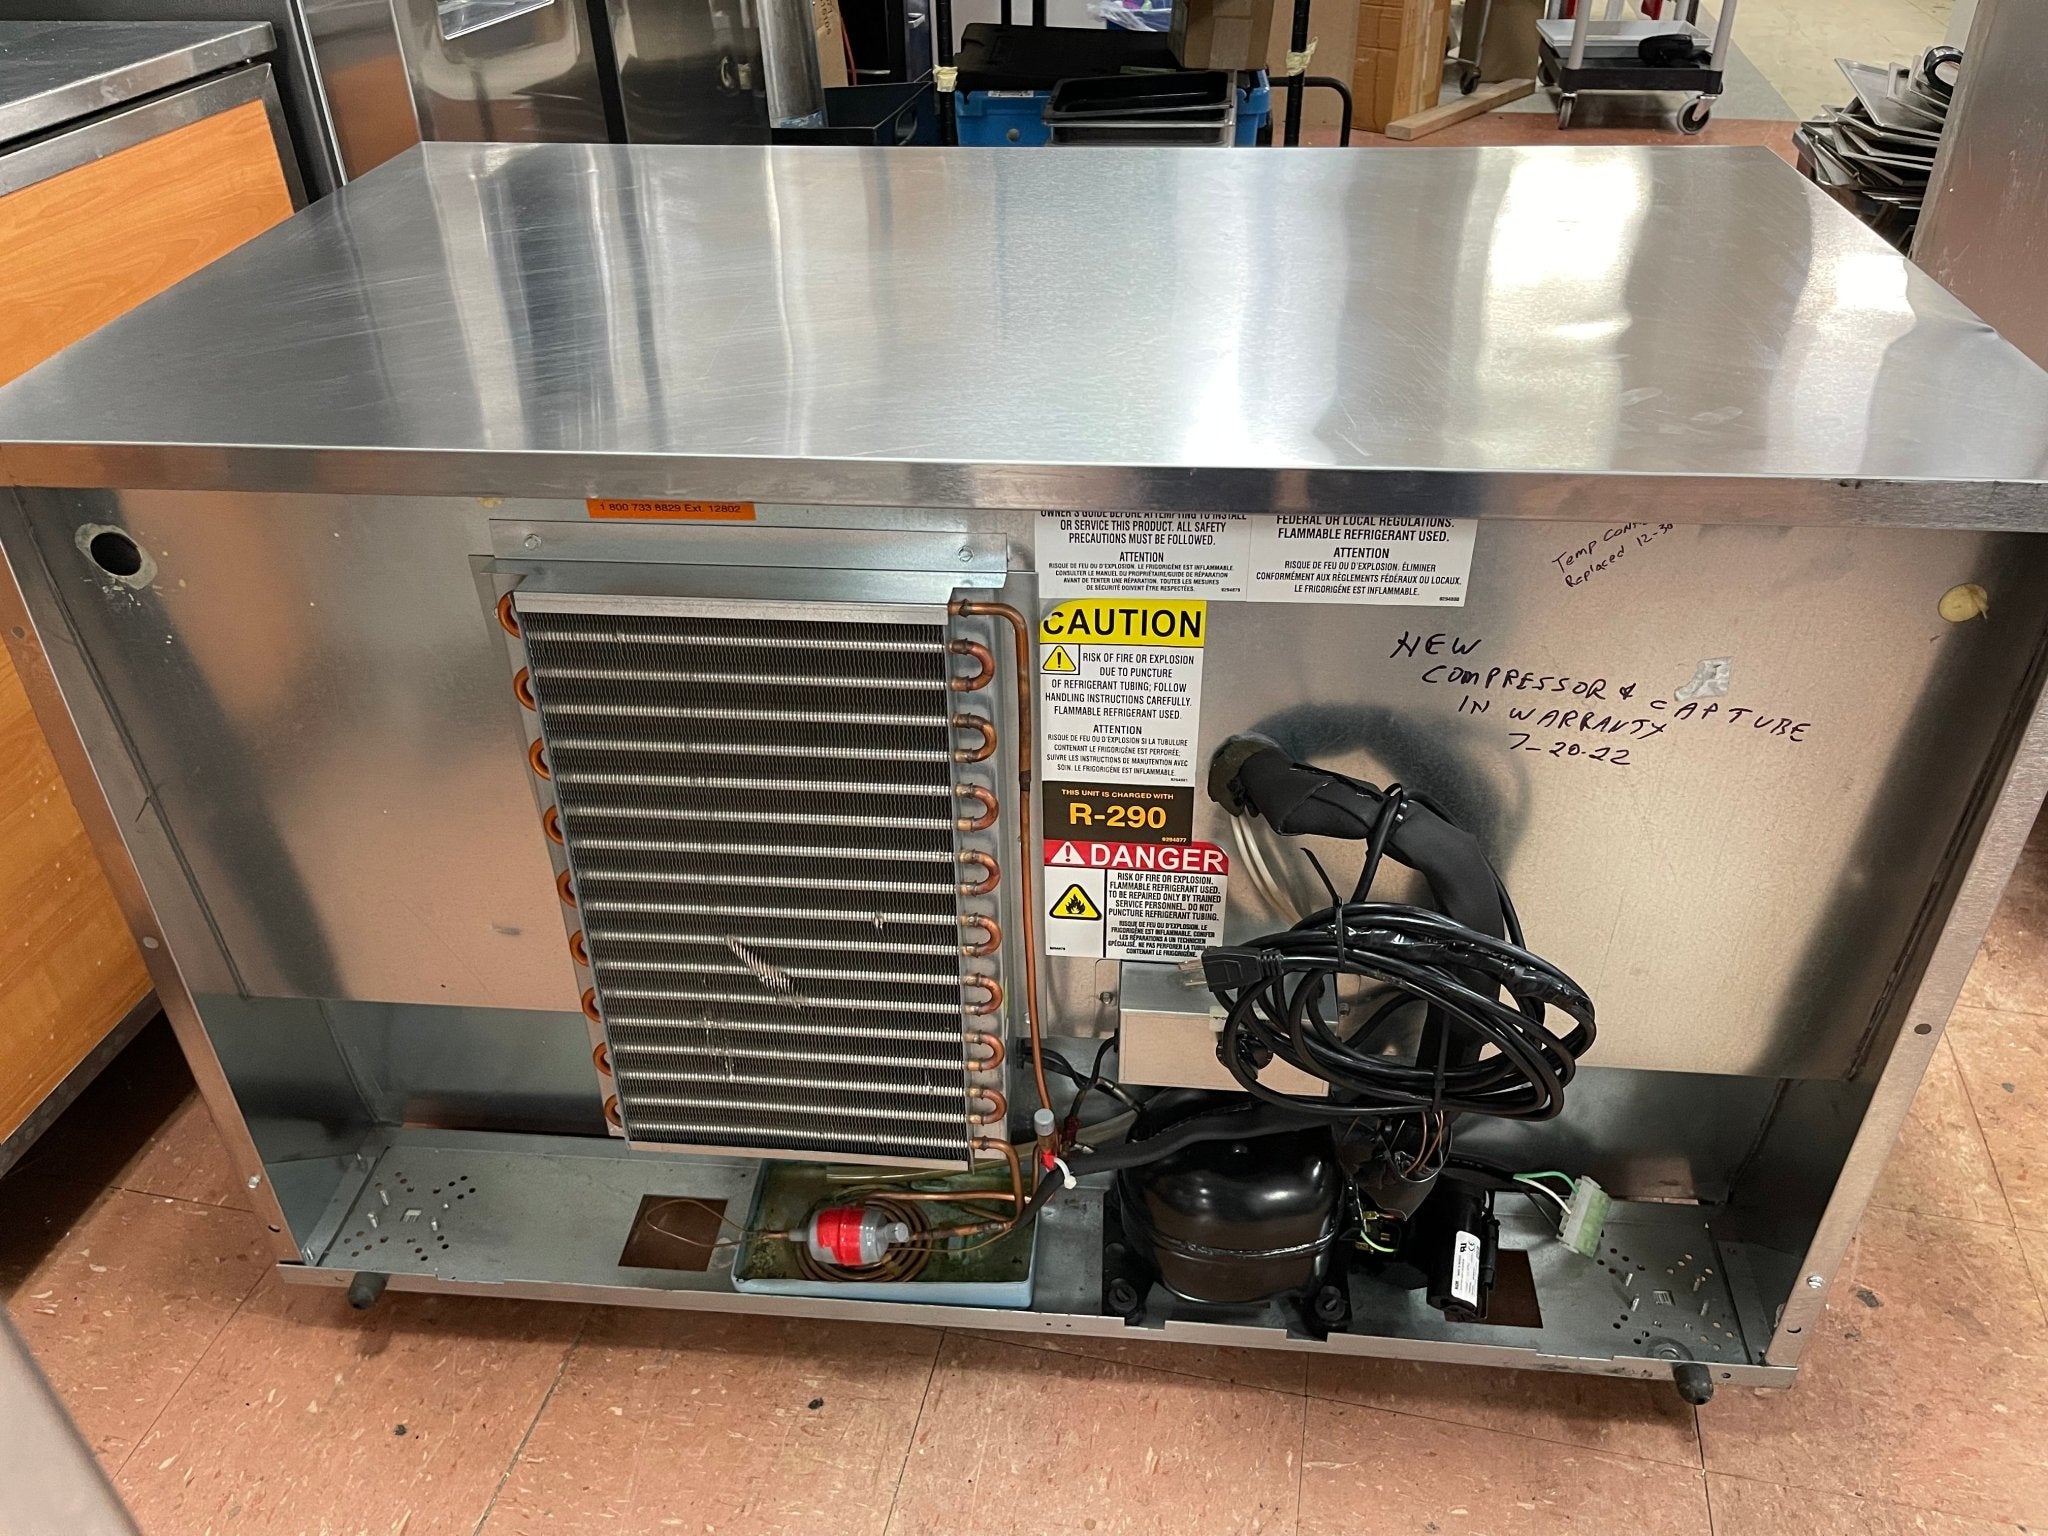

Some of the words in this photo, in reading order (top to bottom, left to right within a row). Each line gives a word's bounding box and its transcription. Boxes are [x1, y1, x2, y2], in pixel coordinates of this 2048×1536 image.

[608, 502, 628, 511] 800
[630, 503, 651, 512] 733
[653, 503, 681, 512] 8829
[707, 504, 741, 513] 12802
[1060, 519, 1072, 531] OR
[1074, 519, 1109, 531] SERVICE
[1110, 520, 1130, 532] THIS
[1132, 520, 1174, 532] PRODUCT.
[1175, 521, 1192, 533] ALL
[1193, 521, 1227, 533] SAFETY
[1276, 515, 1323, 526] FEDERAL
[1323, 516, 1340, 526] OR
[1341, 516, 1377, 527] LOCAL
[1378, 517, 1456, 528] REGULATIONS.
[1068, 533, 1126, 545] PRECAUTIONS
[1128, 533, 1153, 545] MUST
[1154, 533, 1165, 545] BE
[1166, 534, 1217, 546] FOLLOWED.
[1277, 528, 1342, 540] FLAMMABLE
[1342, 529, 1416, 542] REFRIGERANT
[1417, 530, 1451, 542] USED.
[1119, 551, 1165, 563] ATTENTION
[1332, 547, 1391, 559] ATTENTION
[1349, 562, 1400, 572] D'EXPLOSION.
[1401, 563, 1437, 573] ÉLIMINER
[1315, 572, 1331, 582] AUX
[1379, 574, 1418, 584] FÉDÉRAUX
[1418, 574, 1430, 585] OU
[1430, 575, 1463, 585] LOCAUX.
[1351, 585, 1366, 595] EST
[1366, 585, 1421, 596] INFLAMMABLE.
[1042, 608, 1201, 638] CAUTION
[1389, 631, 1482, 658] NEW
[1082, 653, 1101, 663] RISK
[1103, 653, 1113, 663] OF
[1115, 653, 1133, 663] FIRE
[1135, 654, 1147, 664] OR
[1149, 654, 1195, 665] EXPLOSION
[1099, 667, 1115, 677] DUE
[1117, 667, 1128, 677] TO
[1129, 668, 1173, 678] PUNCTURE
[1063, 680, 1117, 690] REFRIGERANT
[1119, 681, 1151, 691] TUBING;
[1153, 682, 1187, 693] FOLLOW
[1421, 665, 1607, 700] COMPRESSOR
[1619, 683, 1637, 700] &
[1045, 693, 1084, 703] HANDLING
[1086, 694, 1144, 705] INSTRUCTIONS
[1146, 695, 1192, 707] CAREFULLY.
[1054, 706, 1101, 717] FLAMMABLE
[1103, 707, 1157, 719] REFRIGERANT
[1158, 709, 1182, 720] USED.
[1458, 695, 1490, 714] IN
[1509, 707, 1667, 740] WARRANTY
[1093, 724, 1143, 735] ATTENTION
[1069, 802, 1167, 829] R-290
[1090, 844, 1224, 873] DANGER
[1117, 872, 1133, 882] RISK
[1145, 873, 1160, 883] FIRE
[1173, 875, 1214, 885] EXPLOSION.
[1109, 881, 1150, 891] FLAMMABLE
[1151, 883, 1198, 894] REFRIGERANT
[1199, 885, 1221, 895] USED.
[1128, 891, 1161, 901] REPAIRED
[1162, 892, 1180, 902] ONLY
[1192, 893, 1222, 904] TRAINED
[1115, 899, 1143, 909] SERVICE
[1144, 900, 1186, 911] PERSONNEL.
[1198, 903, 1214, 912] NOT
[1108, 908, 1143, 918] PUNCTURE
[1144, 909, 1190, 920] REFRIGERANT
[1191, 911, 1219, 922] TUBING.
